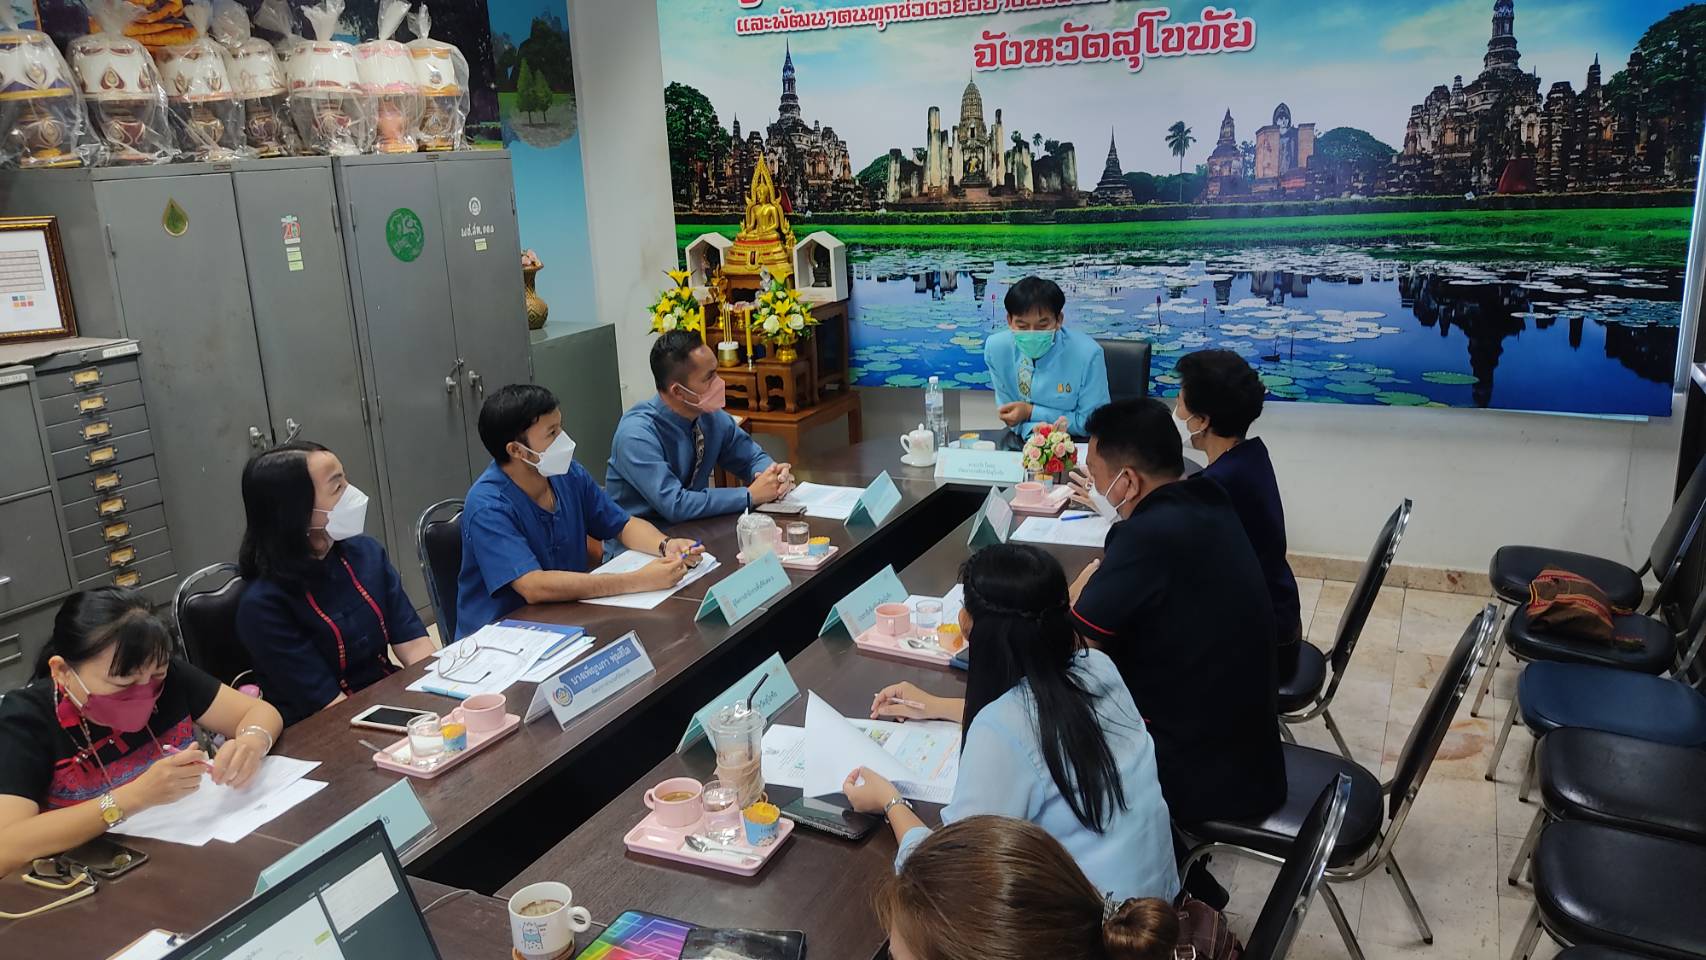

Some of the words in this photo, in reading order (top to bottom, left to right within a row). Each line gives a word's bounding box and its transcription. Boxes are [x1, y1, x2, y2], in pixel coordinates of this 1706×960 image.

[973, 9, 1254, 70] จังหวัดสุโขทัย
